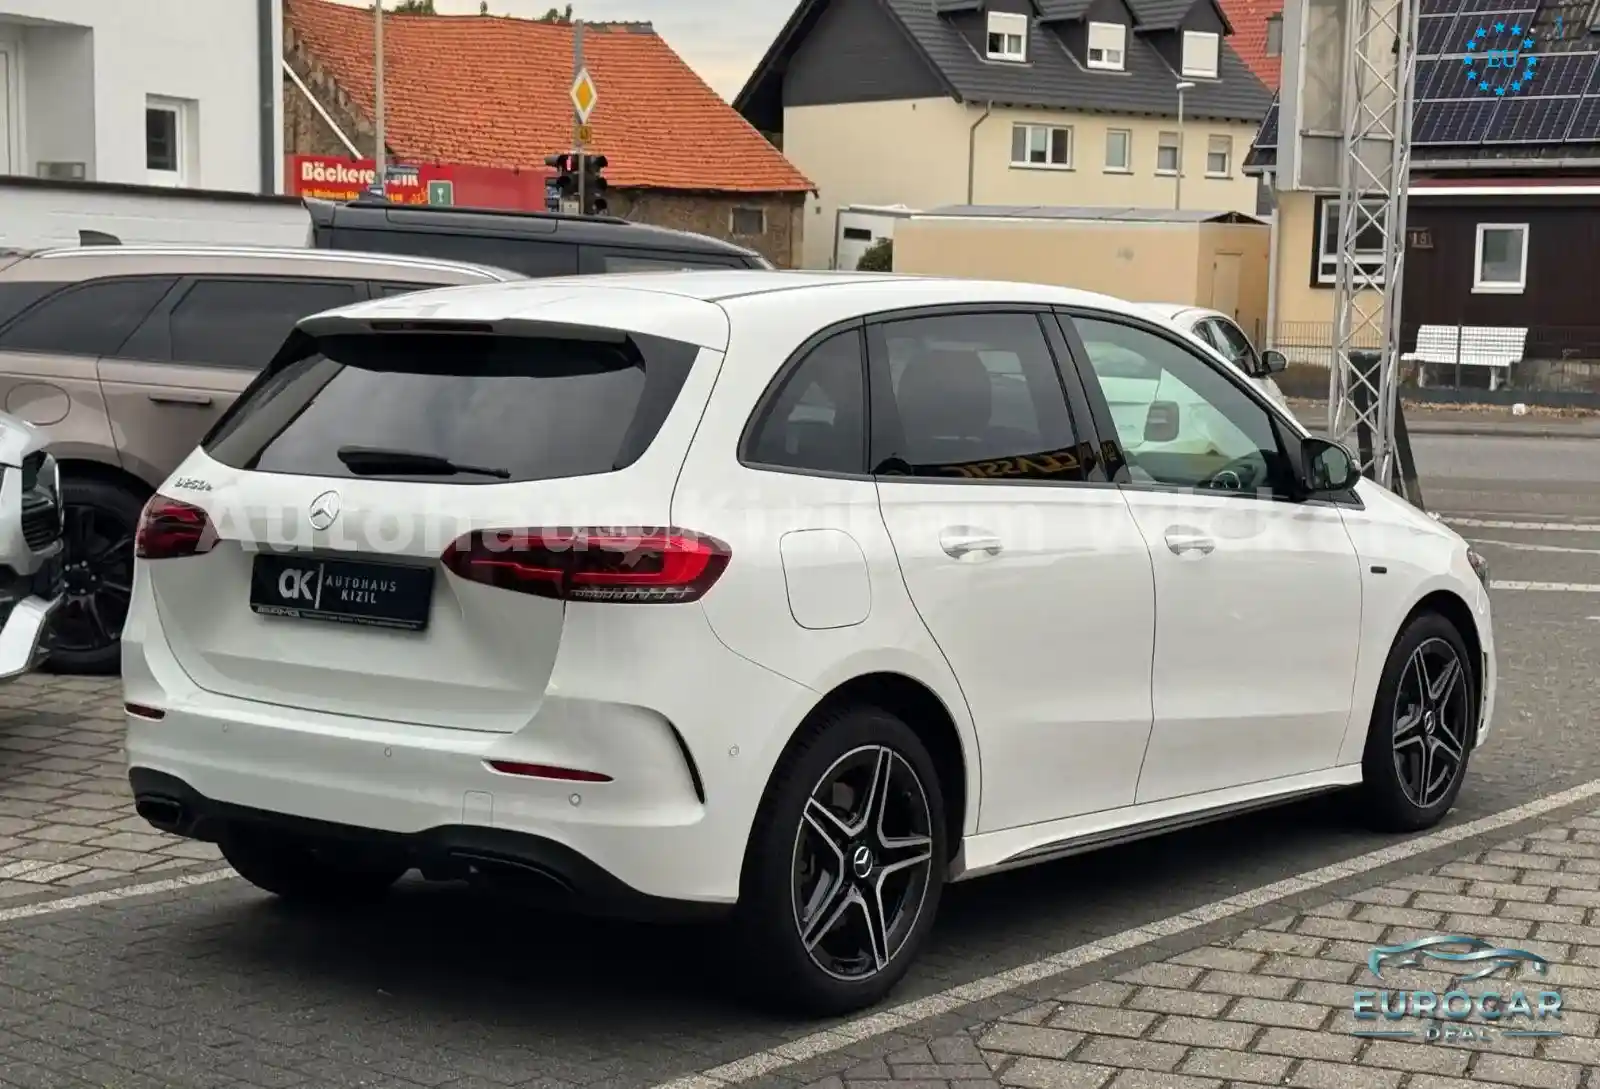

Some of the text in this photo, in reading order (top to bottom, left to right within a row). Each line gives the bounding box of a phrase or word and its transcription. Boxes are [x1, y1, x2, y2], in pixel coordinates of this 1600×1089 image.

[302, 161, 376, 185] Bäckere
[325, 575, 397, 592] AUTOHAUS
[341, 589, 377, 604] KIZIL
